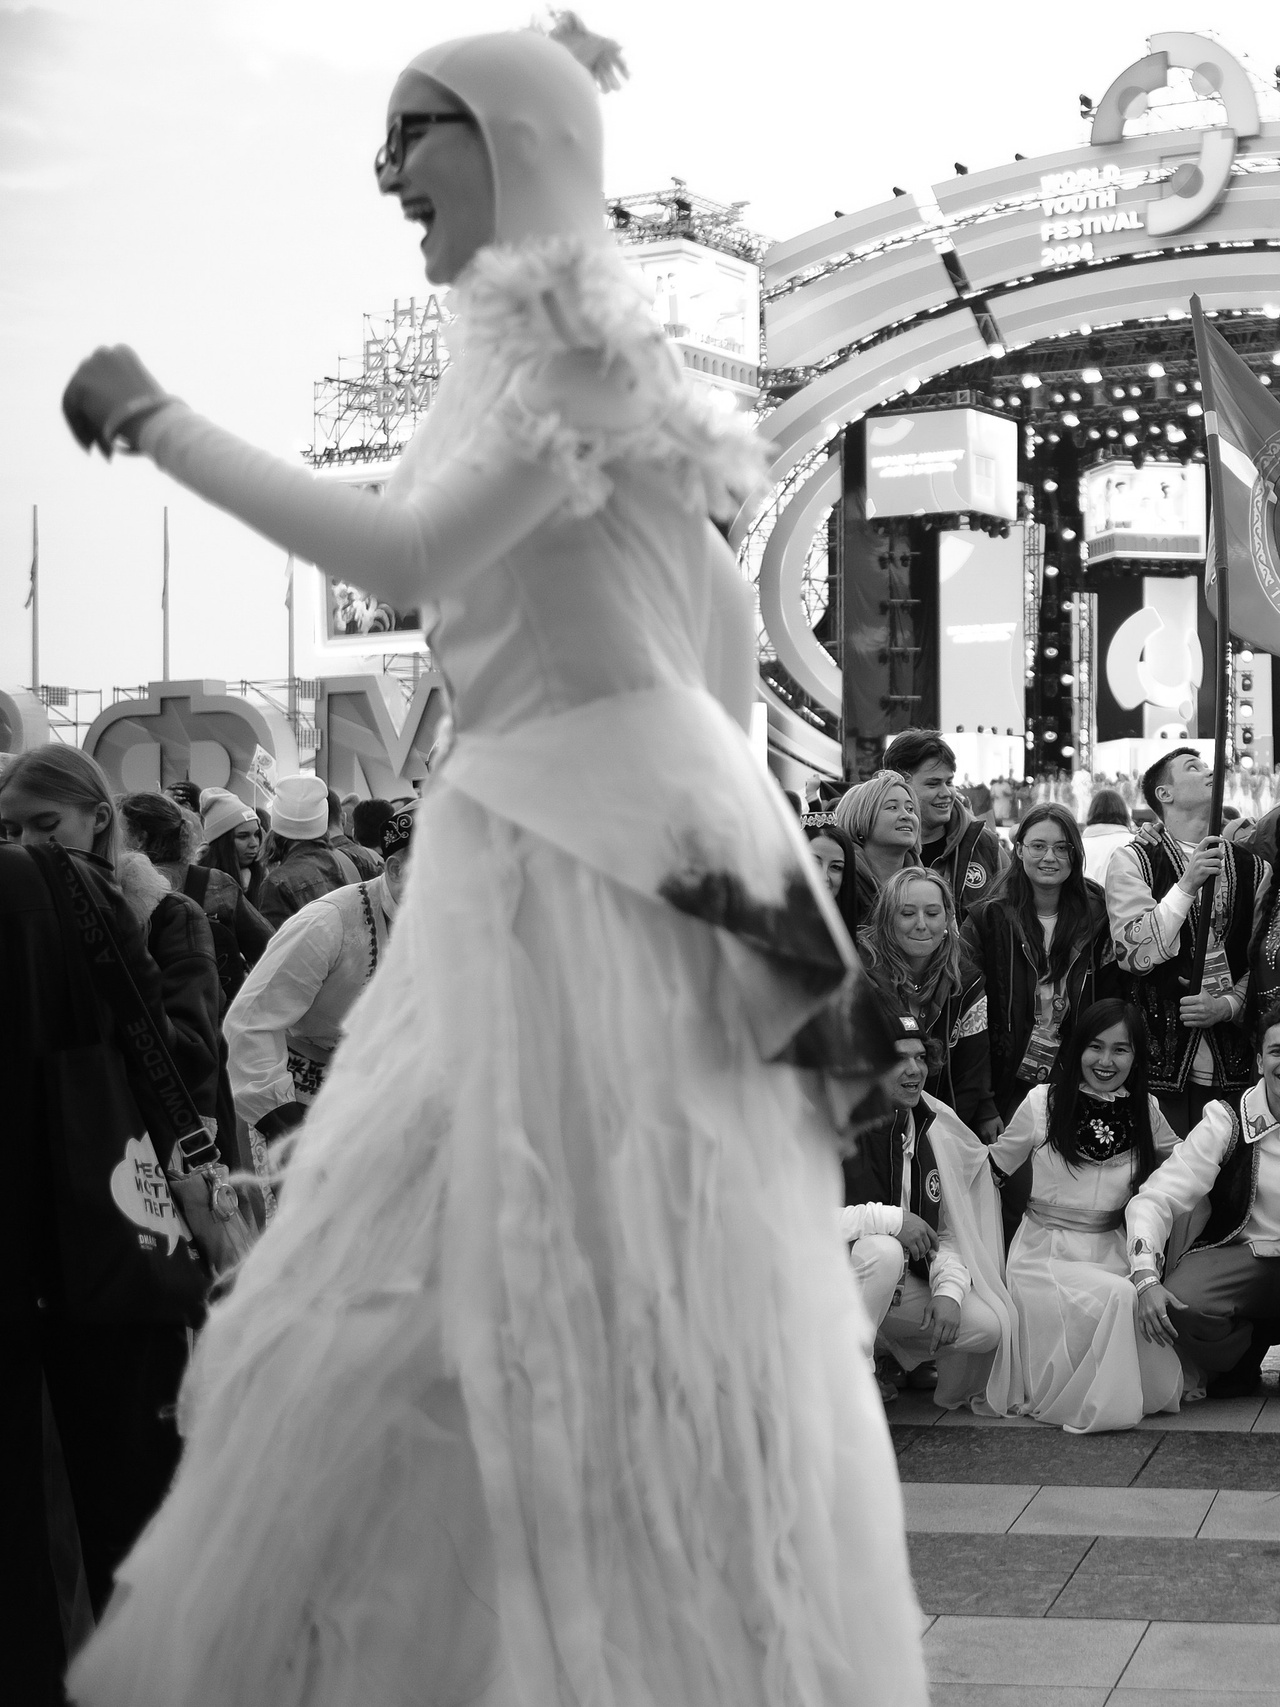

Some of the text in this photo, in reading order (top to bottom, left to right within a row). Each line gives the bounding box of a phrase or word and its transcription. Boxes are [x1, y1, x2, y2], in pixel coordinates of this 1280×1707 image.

[1041, 165, 1120, 190] WORLD
[1041, 190, 1116, 216] YOUTH
[1041, 211, 1144, 242] FESTIVAL
[1041, 242, 1095, 267] 2024
